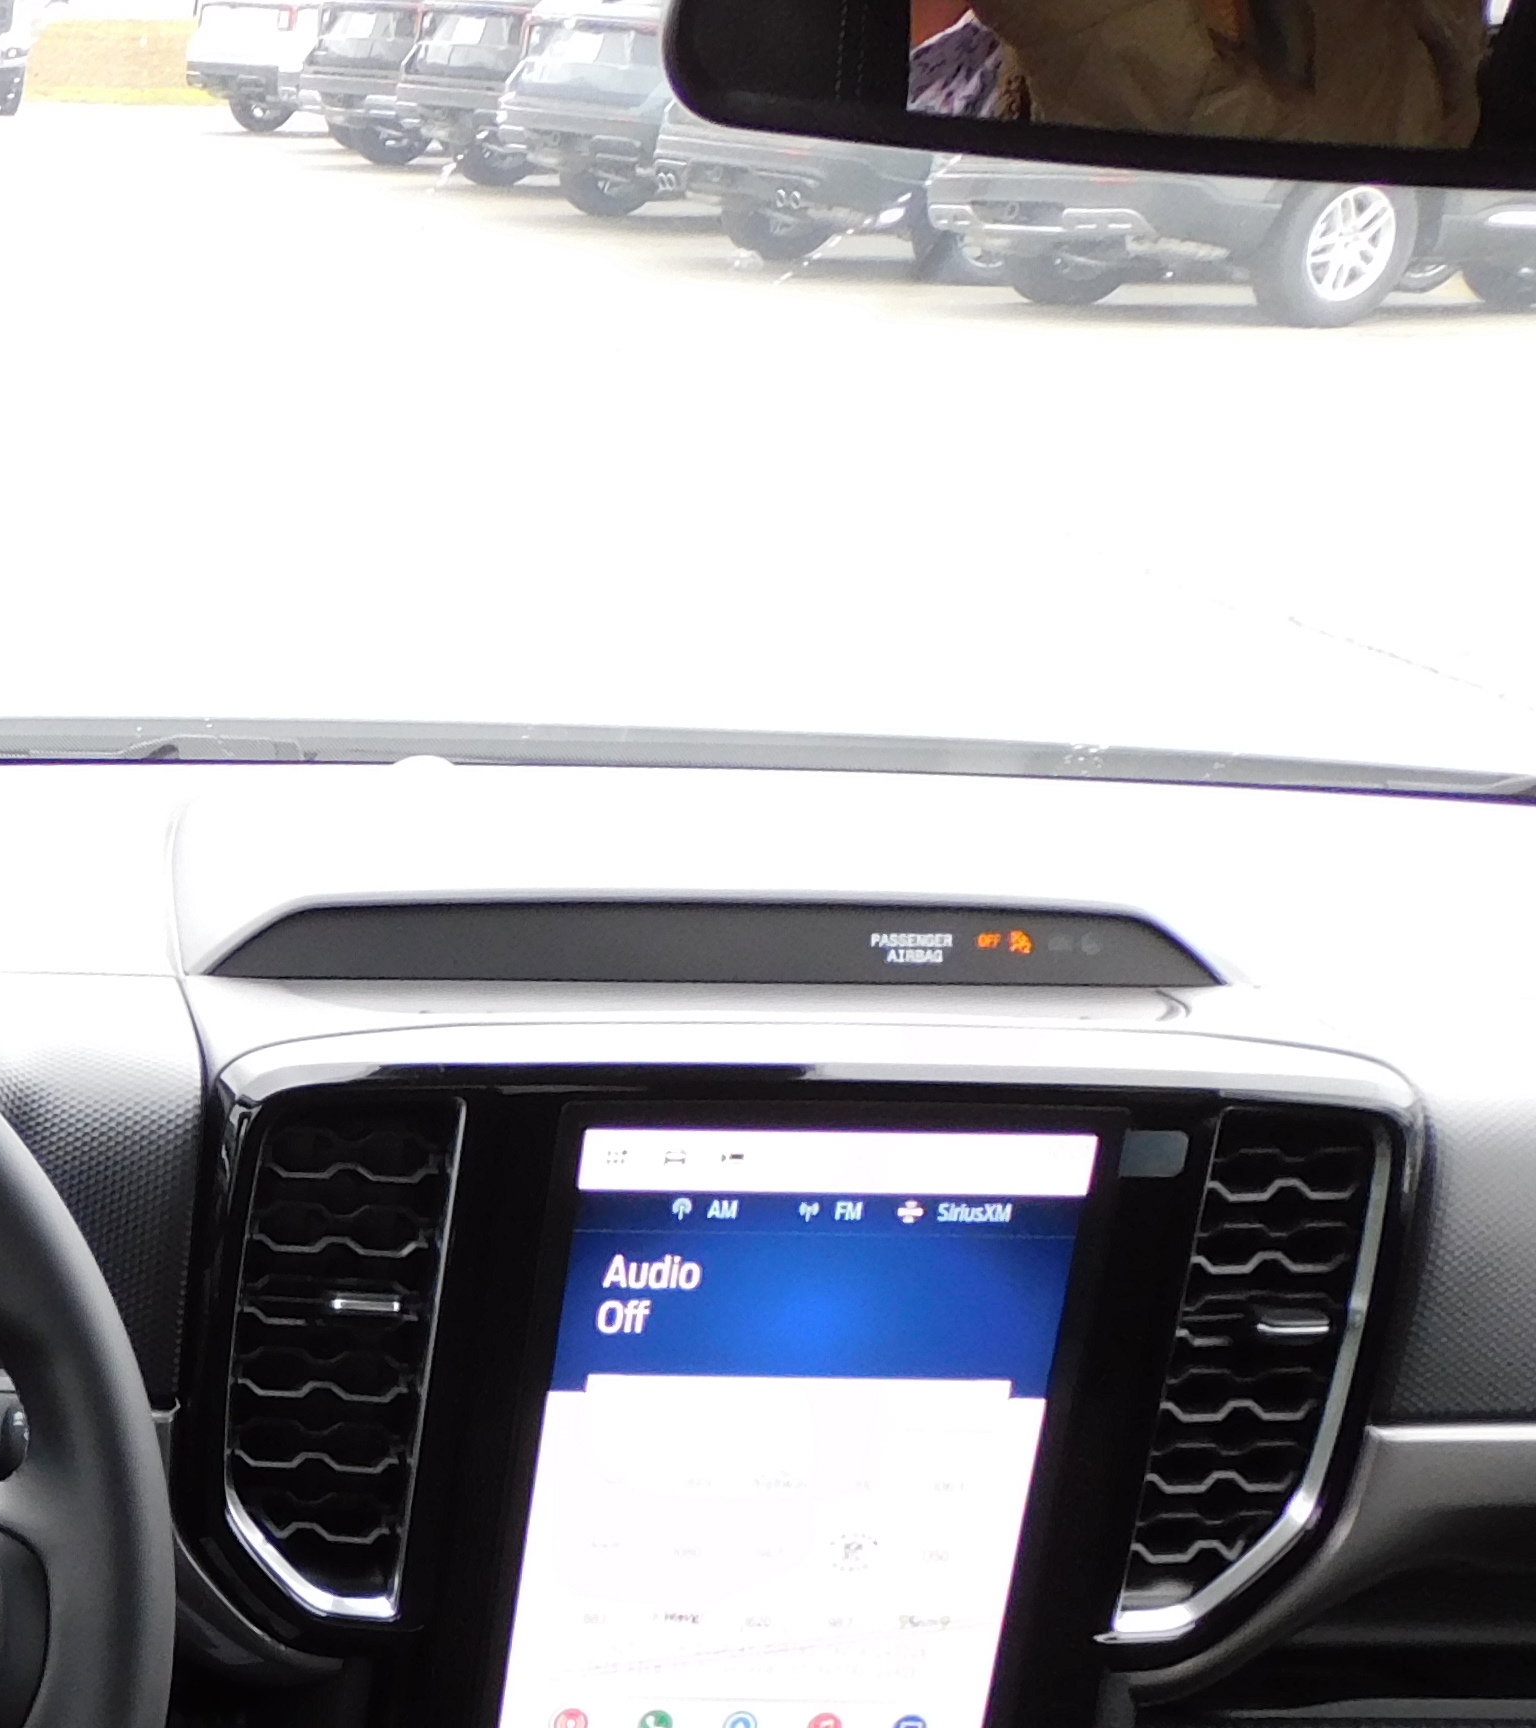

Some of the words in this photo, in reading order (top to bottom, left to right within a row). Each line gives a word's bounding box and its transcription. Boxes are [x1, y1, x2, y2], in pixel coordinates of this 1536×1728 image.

[870, 932, 953, 948] PASSENGER
[977, 932, 1002, 948] OFF
[886, 949, 944, 963] AIRBAG
[707, 1200, 739, 1219] AM
[834, 1202, 863, 1220] FM
[937, 1201, 1012, 1223] SiriusXM
[602, 1254, 702, 1290] Audio
[596, 1299, 651, 1334] Off
